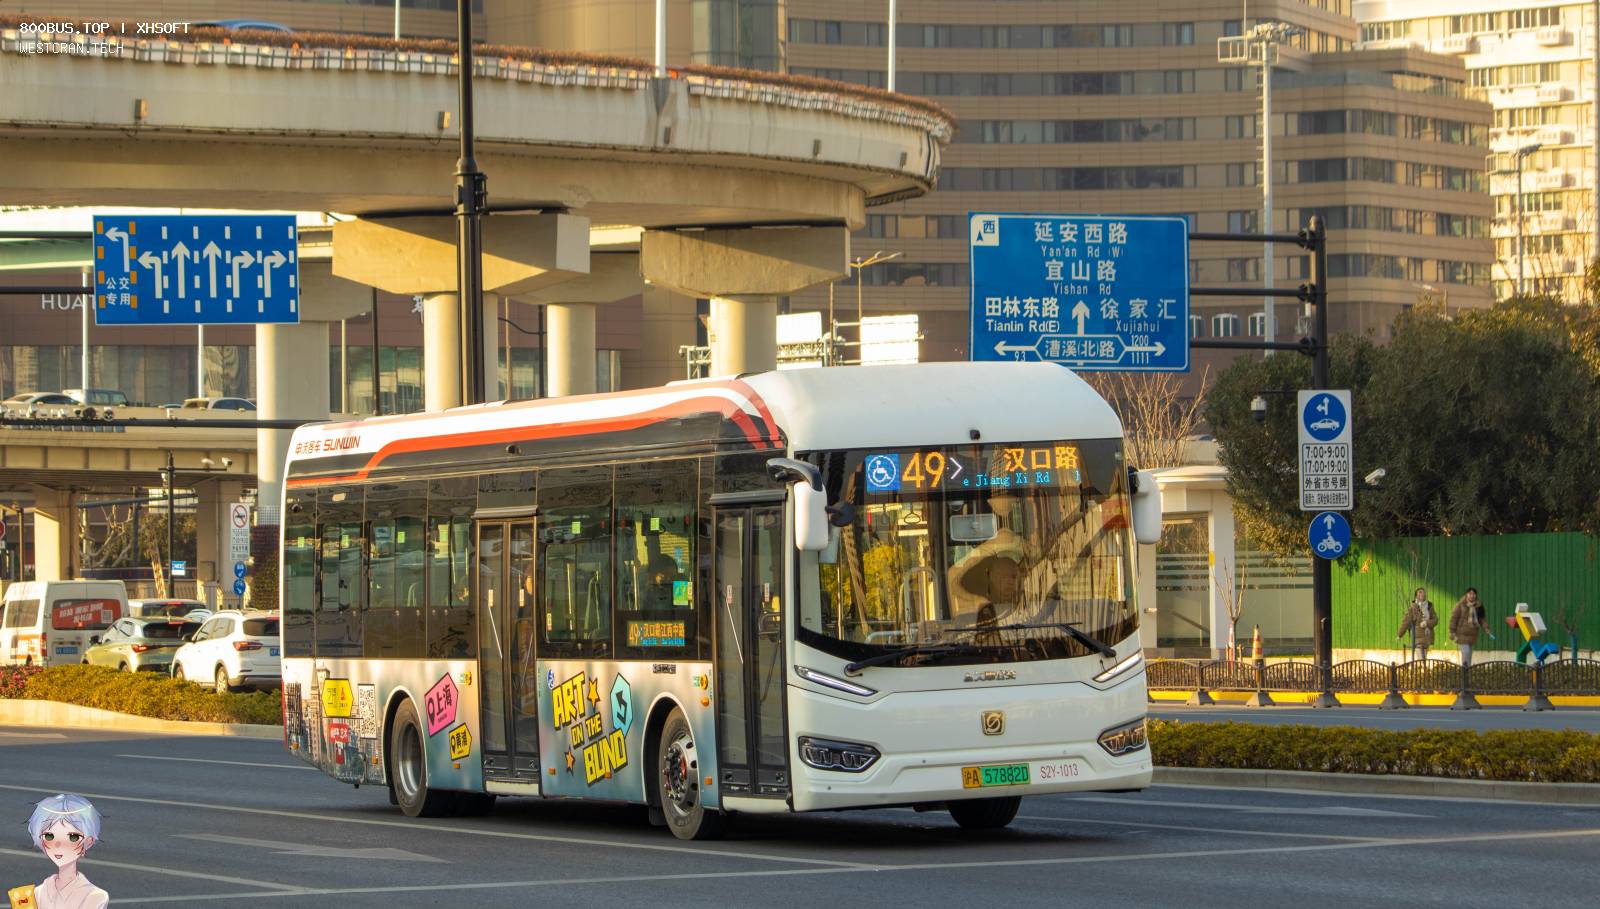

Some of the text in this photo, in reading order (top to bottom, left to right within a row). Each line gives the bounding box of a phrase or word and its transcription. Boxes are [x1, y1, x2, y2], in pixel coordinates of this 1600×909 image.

[983, 220, 995, 234] 西
[1034, 222, 1128, 244] 延安西路
[1041, 245, 1077, 257] Yan'an
[1087, 246, 1100, 257] Rd
[1045, 259, 1117, 281] 宜山路
[106, 277, 130, 290] 公交
[1053, 282, 1111, 295] Yishan Rd
[106, 293, 131, 306] 专用
[985, 297, 1060, 318] 田林东路
[1100, 298, 1177, 320] 徐家汇
[986, 320, 1024, 333] Tianlin
[1116, 319, 1160, 335] Xujiahui
[1131, 335, 1149, 347] 1200
[1131, 351, 1149, 365] 1111
[323, 435, 361, 451] SUNWIN
[1004, 446, 1078, 471] 汉口路
[902, 452, 945, 488] 49
[976, 474, 1011, 487] Jiang
[1016, 472, 1028, 484] Xi
[1035, 471, 1051, 483] Rd
[1304, 477, 1348, 489] 外省市号牌
[629, 623, 639, 645] 49
[436, 684, 453, 716] 上海
[552, 671, 586, 730] ART
[571, 713, 603, 749] ON THE
[583, 728, 629, 787] BUND
[1040, 764, 1079, 779] S2Y-1013
